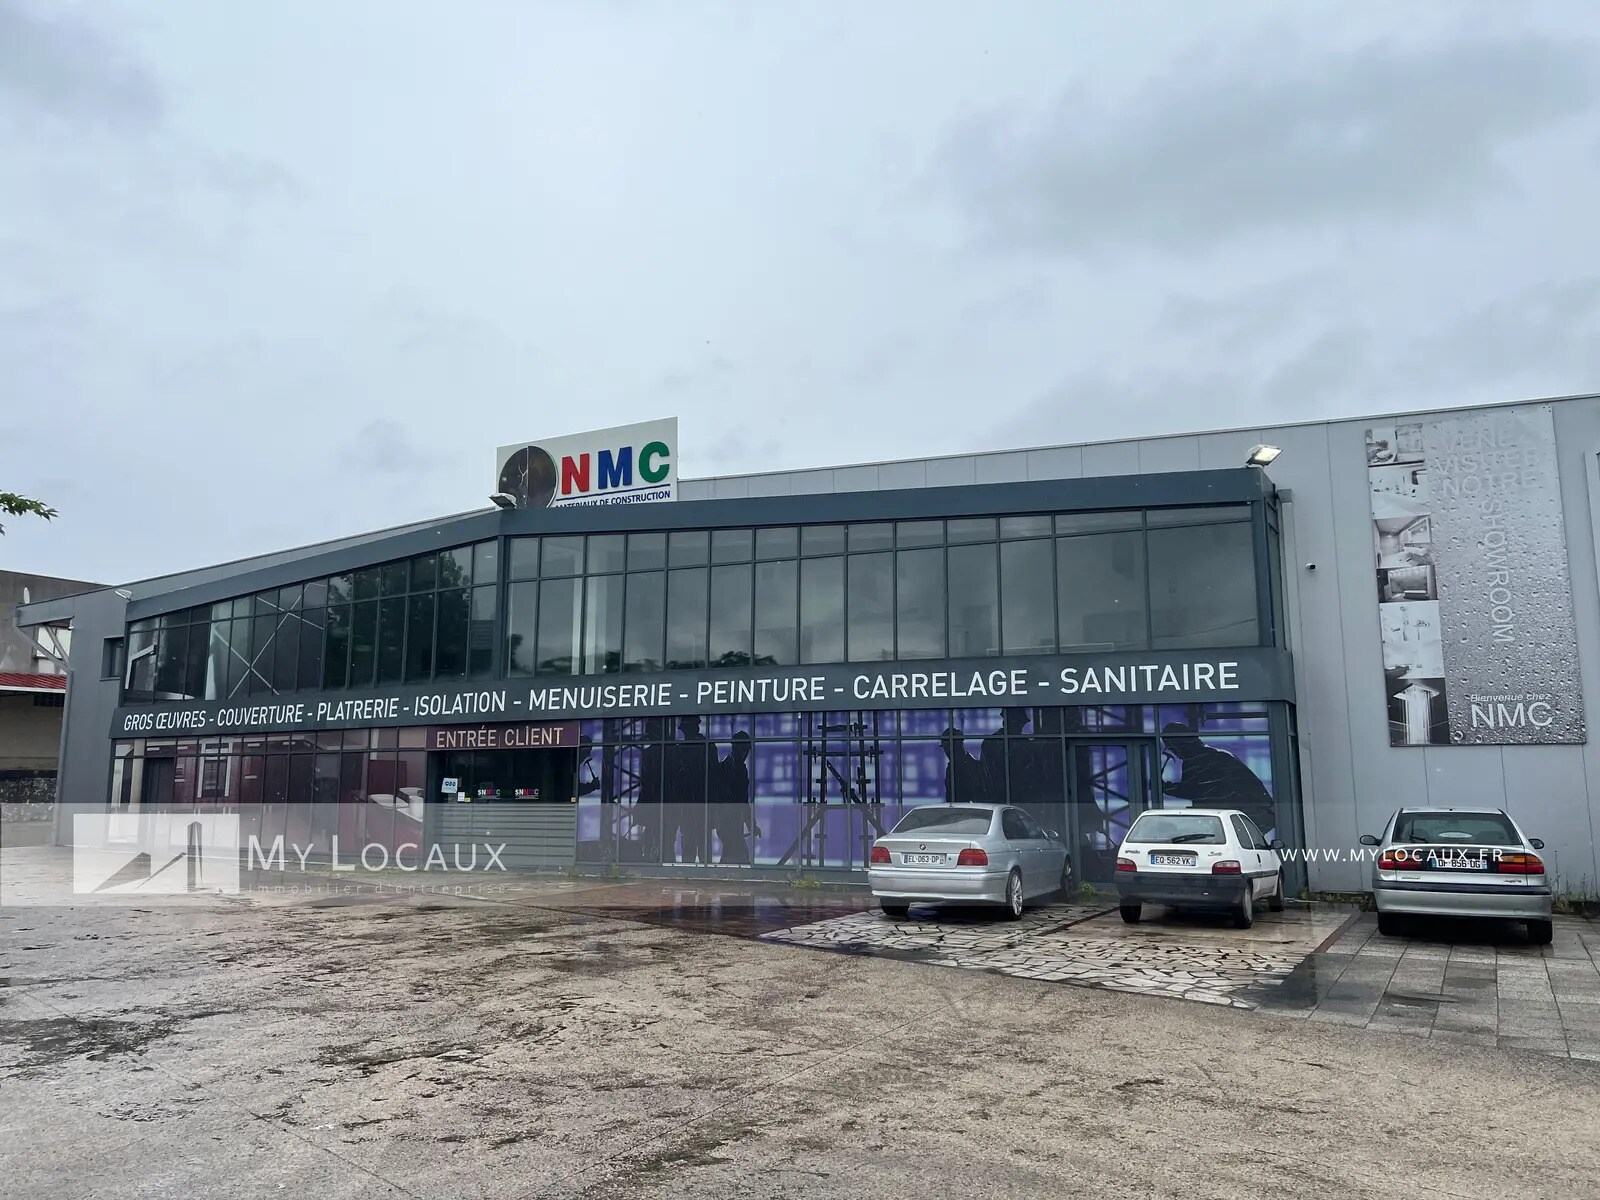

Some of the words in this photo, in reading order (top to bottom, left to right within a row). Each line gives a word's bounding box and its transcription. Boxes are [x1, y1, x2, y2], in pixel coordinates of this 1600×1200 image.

[561, 441, 670, 495] NMC
[1443, 471, 1538, 496] NOTRE
[611, 490, 671, 505] CONSTRUCTION
[1481, 499, 1515, 642] SHOWROOM
[124, 713, 153, 731] GROS
[156, 710, 206, 729] ŒUVRES
[217, 704, 304, 726] COUVERTURE
[316, 697, 399, 721] PLATRERIE
[414, 690, 506, 716] ISOLATION
[529, 683, 672, 711] MENUISERIE
[697, 676, 825, 704] PEINTURE
[853, 670, 1028, 699] CARRELAGE
[1060, 662, 1239, 694] SANITAIRE
[1470, 693, 1523, 702] Bienvenue
[1471, 702, 1553, 729] NMC
[436, 725, 497, 748] ENTRÉE
